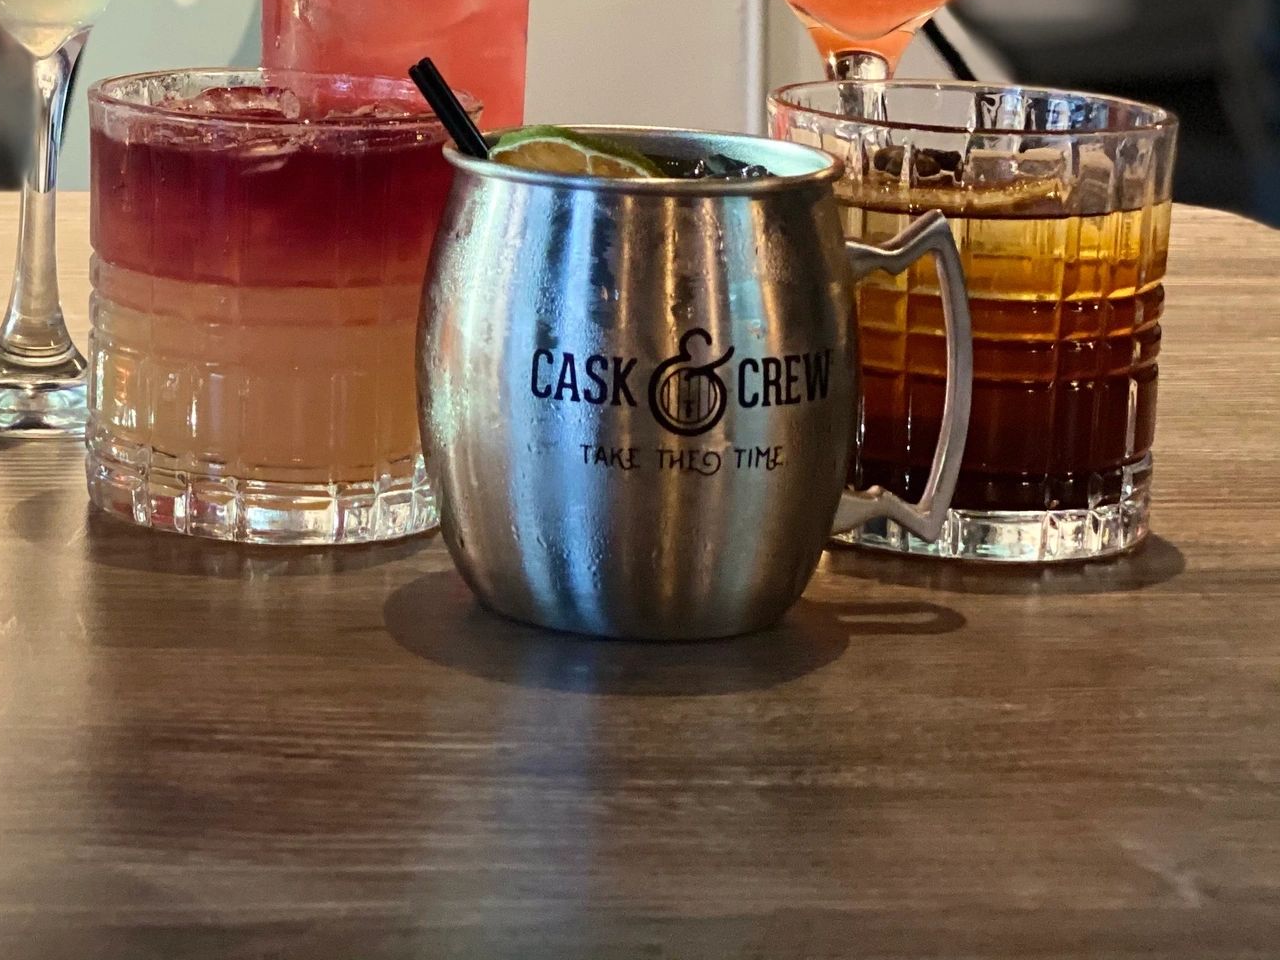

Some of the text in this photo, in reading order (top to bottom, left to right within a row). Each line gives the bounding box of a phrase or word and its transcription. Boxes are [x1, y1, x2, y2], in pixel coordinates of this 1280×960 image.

[531, 327, 834, 437] CASK & CREW
[580, 443, 784, 476] TAKE THE TIME
